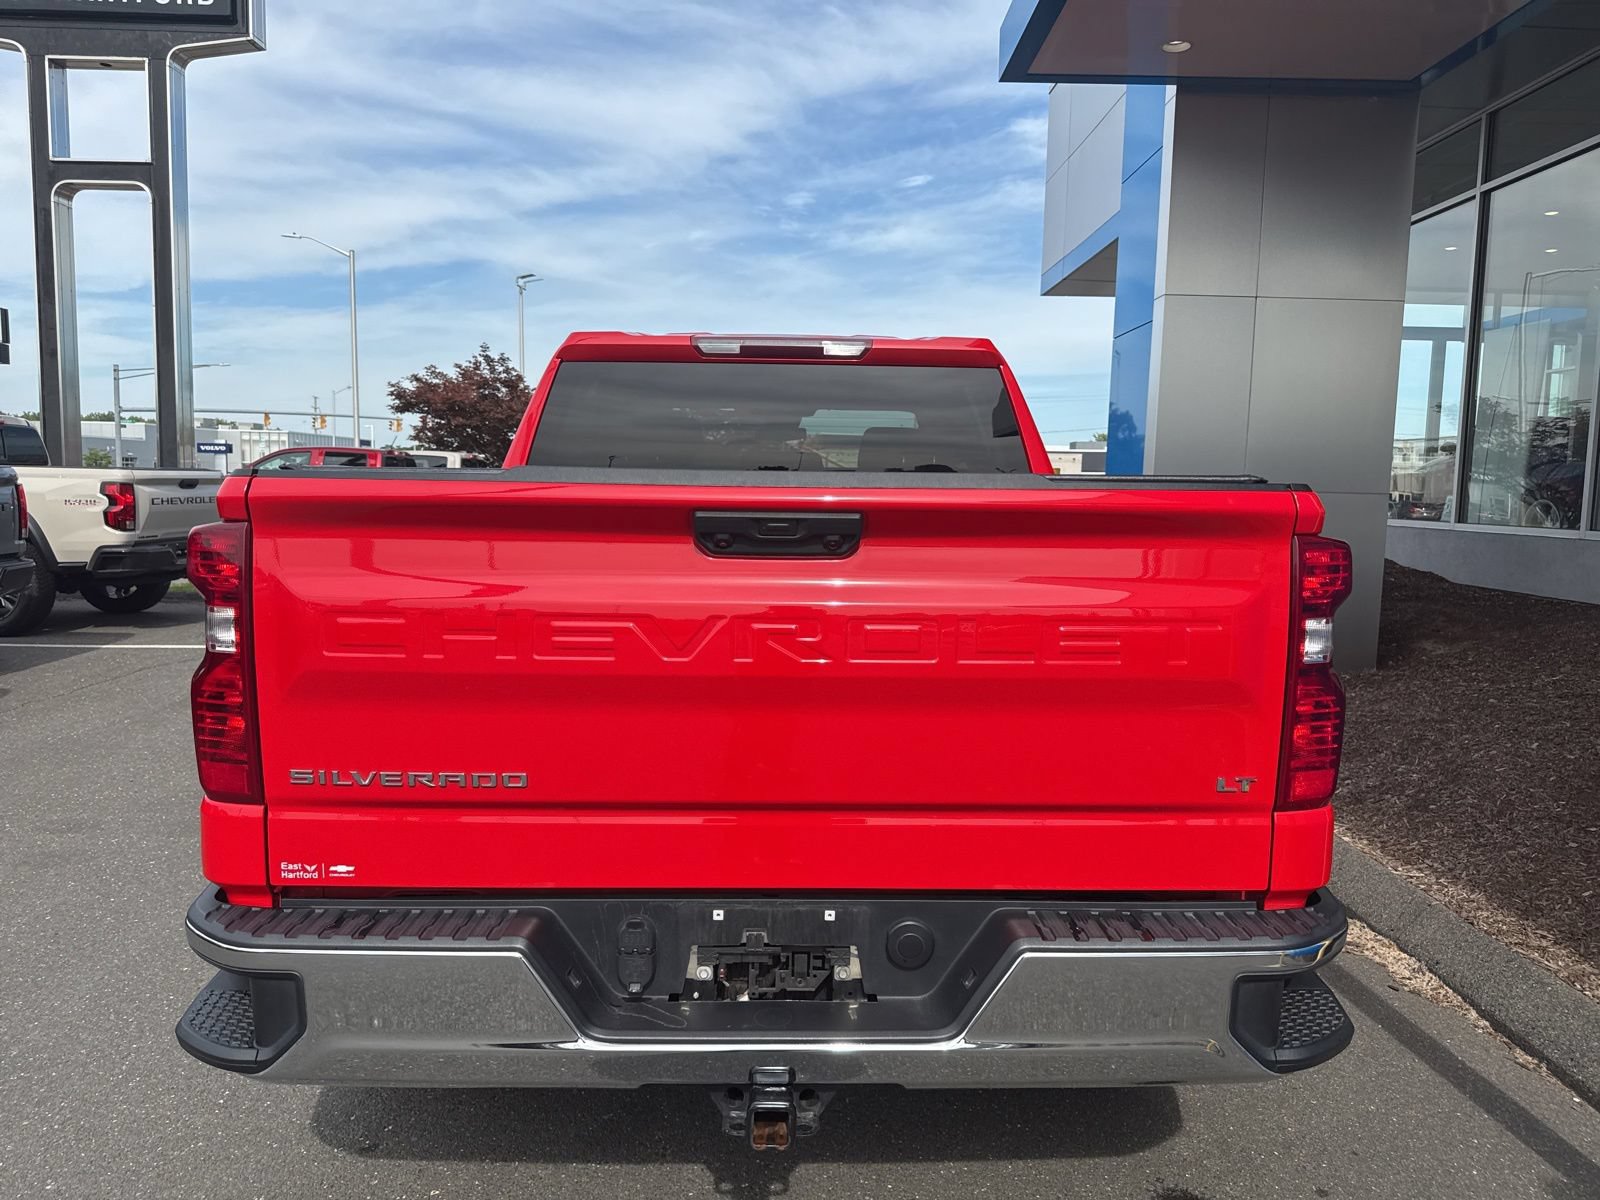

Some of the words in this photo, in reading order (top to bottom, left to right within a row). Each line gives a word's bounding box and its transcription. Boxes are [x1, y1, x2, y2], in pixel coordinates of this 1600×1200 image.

[151, 496, 217, 506] CHEVROLE
[322, 610, 1223, 666] CHEVROLET
[288, 768, 528, 789] SILVERADO
[1216, 776, 1258, 793] LT
[280, 861, 303, 870] East
[281, 871, 319, 879] Hartford
